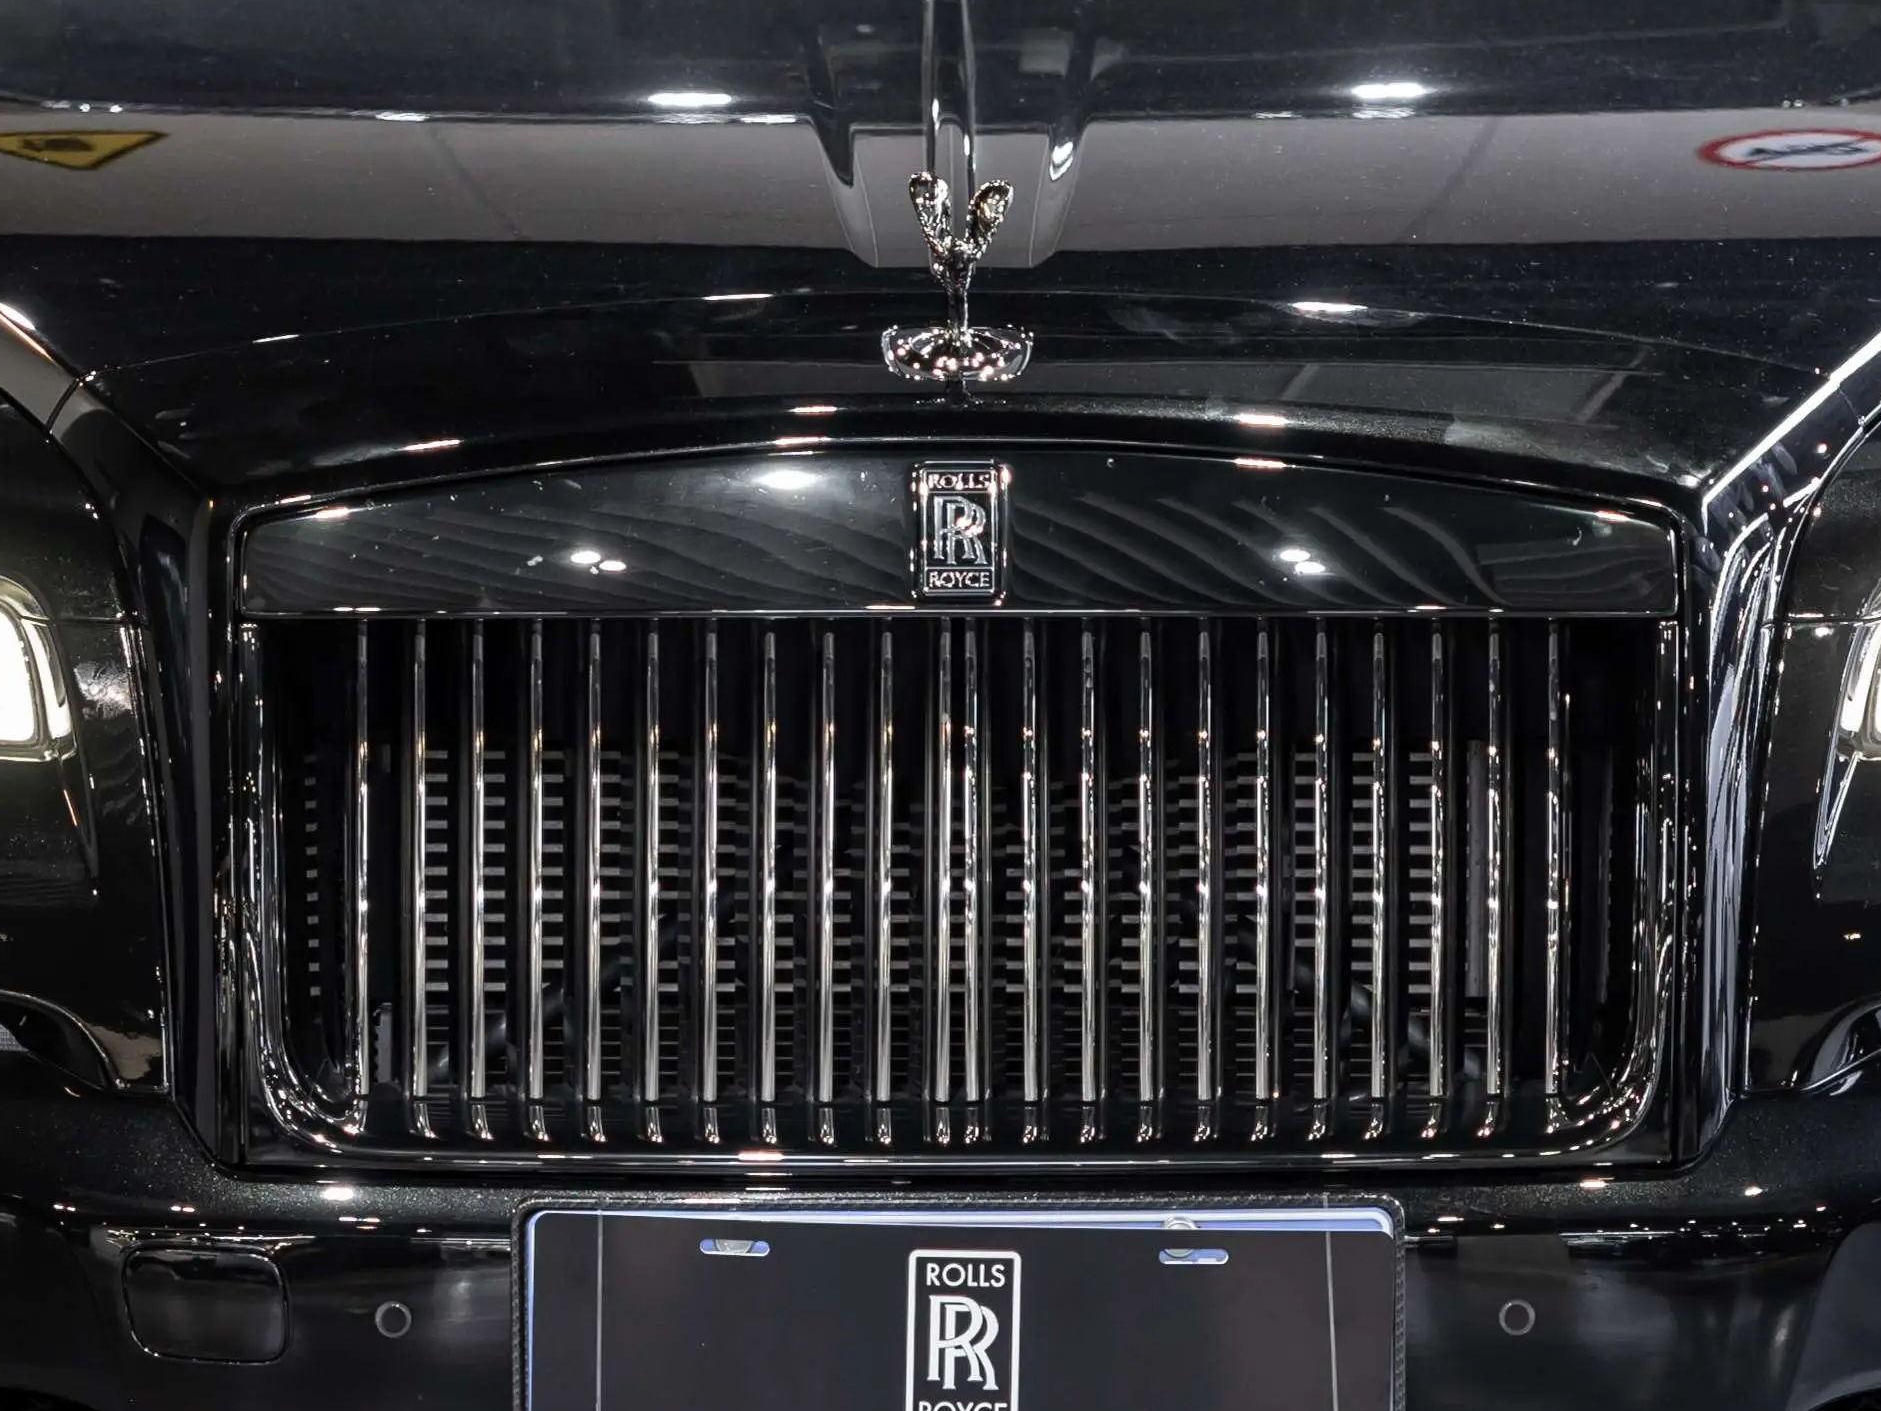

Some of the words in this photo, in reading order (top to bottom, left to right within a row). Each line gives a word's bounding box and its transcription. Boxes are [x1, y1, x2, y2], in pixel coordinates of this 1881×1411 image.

[927, 473, 990, 490] ROLLS
[933, 495, 989, 565] RR
[928, 571, 990, 588] ROYCE
[926, 1262, 1006, 1288] ROLLS
[926, 1294, 1000, 1390] RR
